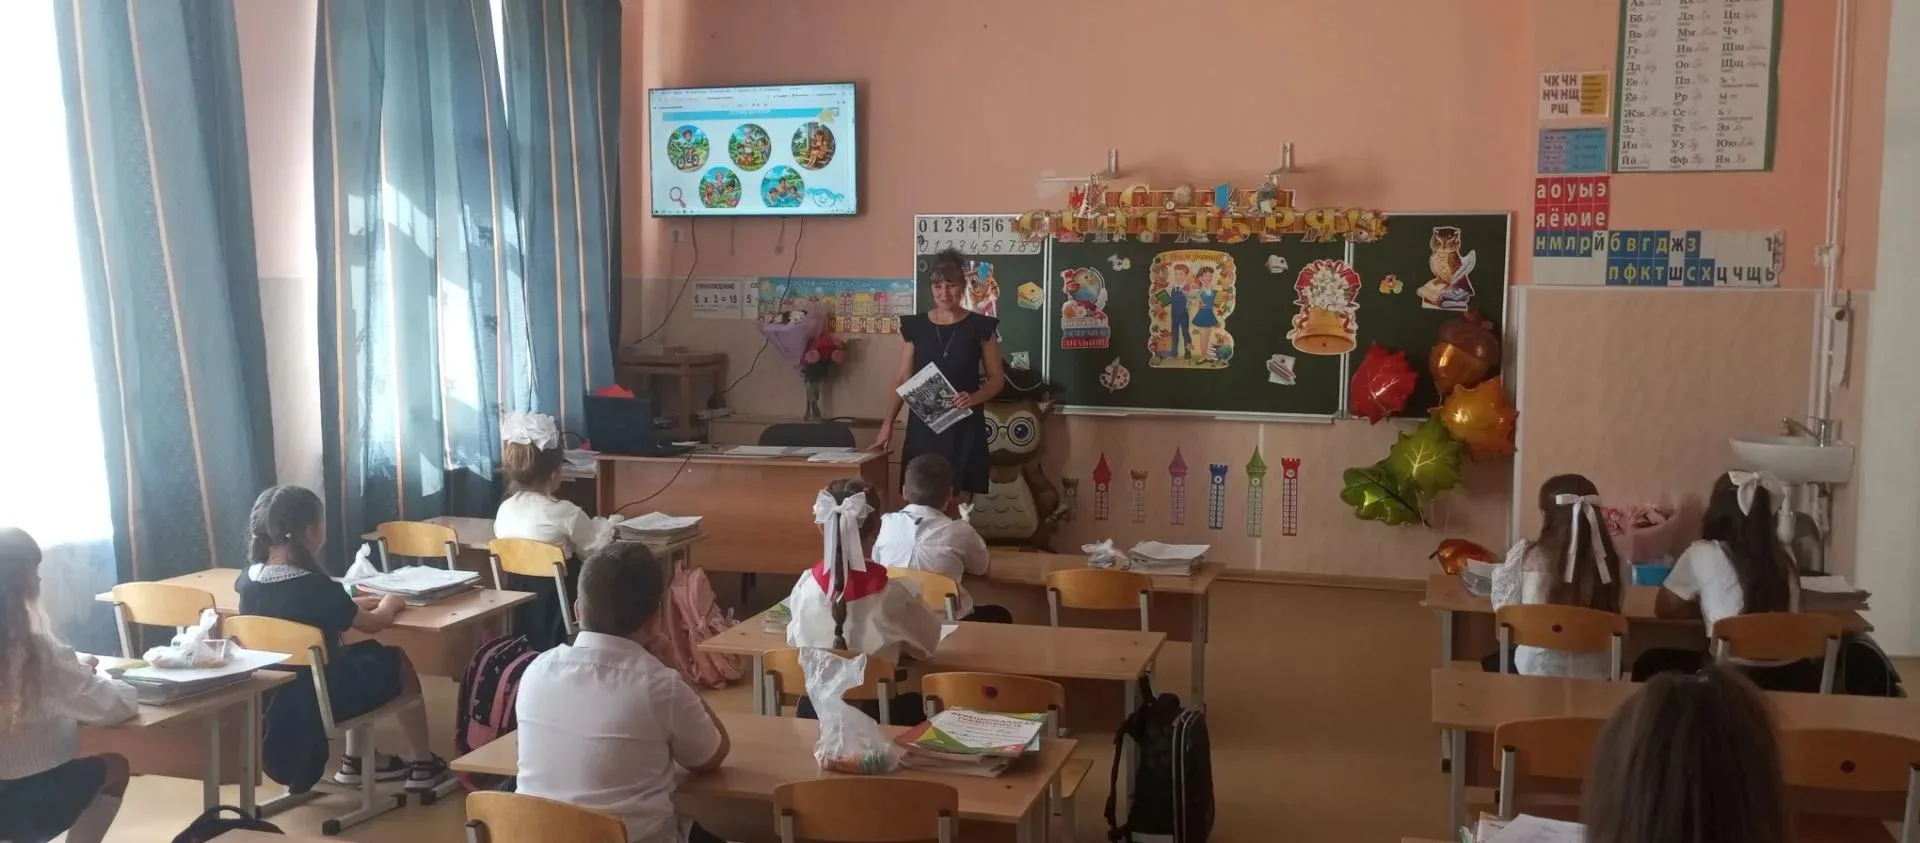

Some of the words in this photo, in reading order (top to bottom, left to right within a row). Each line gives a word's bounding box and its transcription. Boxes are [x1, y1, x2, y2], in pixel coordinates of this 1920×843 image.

[1678, 29, 1696, 37] Мм
[1676, 60, 1690, 69] Оо
[1544, 75, 1559, 86] ЧК
[1561, 74, 1577, 86] ЧН
[1543, 88, 1558, 100] НЧ
[1561, 88, 1579, 102] НЩ
[1674, 92, 1688, 102] Рр
[1551, 103, 1568, 115] РЩ
[1624, 109, 1645, 118] Жж
[1673, 108, 1686, 117] Сс
[1672, 124, 1685, 133] Тт
[1672, 140, 1686, 149] Уу
[1716, 140, 1737, 149] Юю
[1670, 156, 1688, 165] Фф
